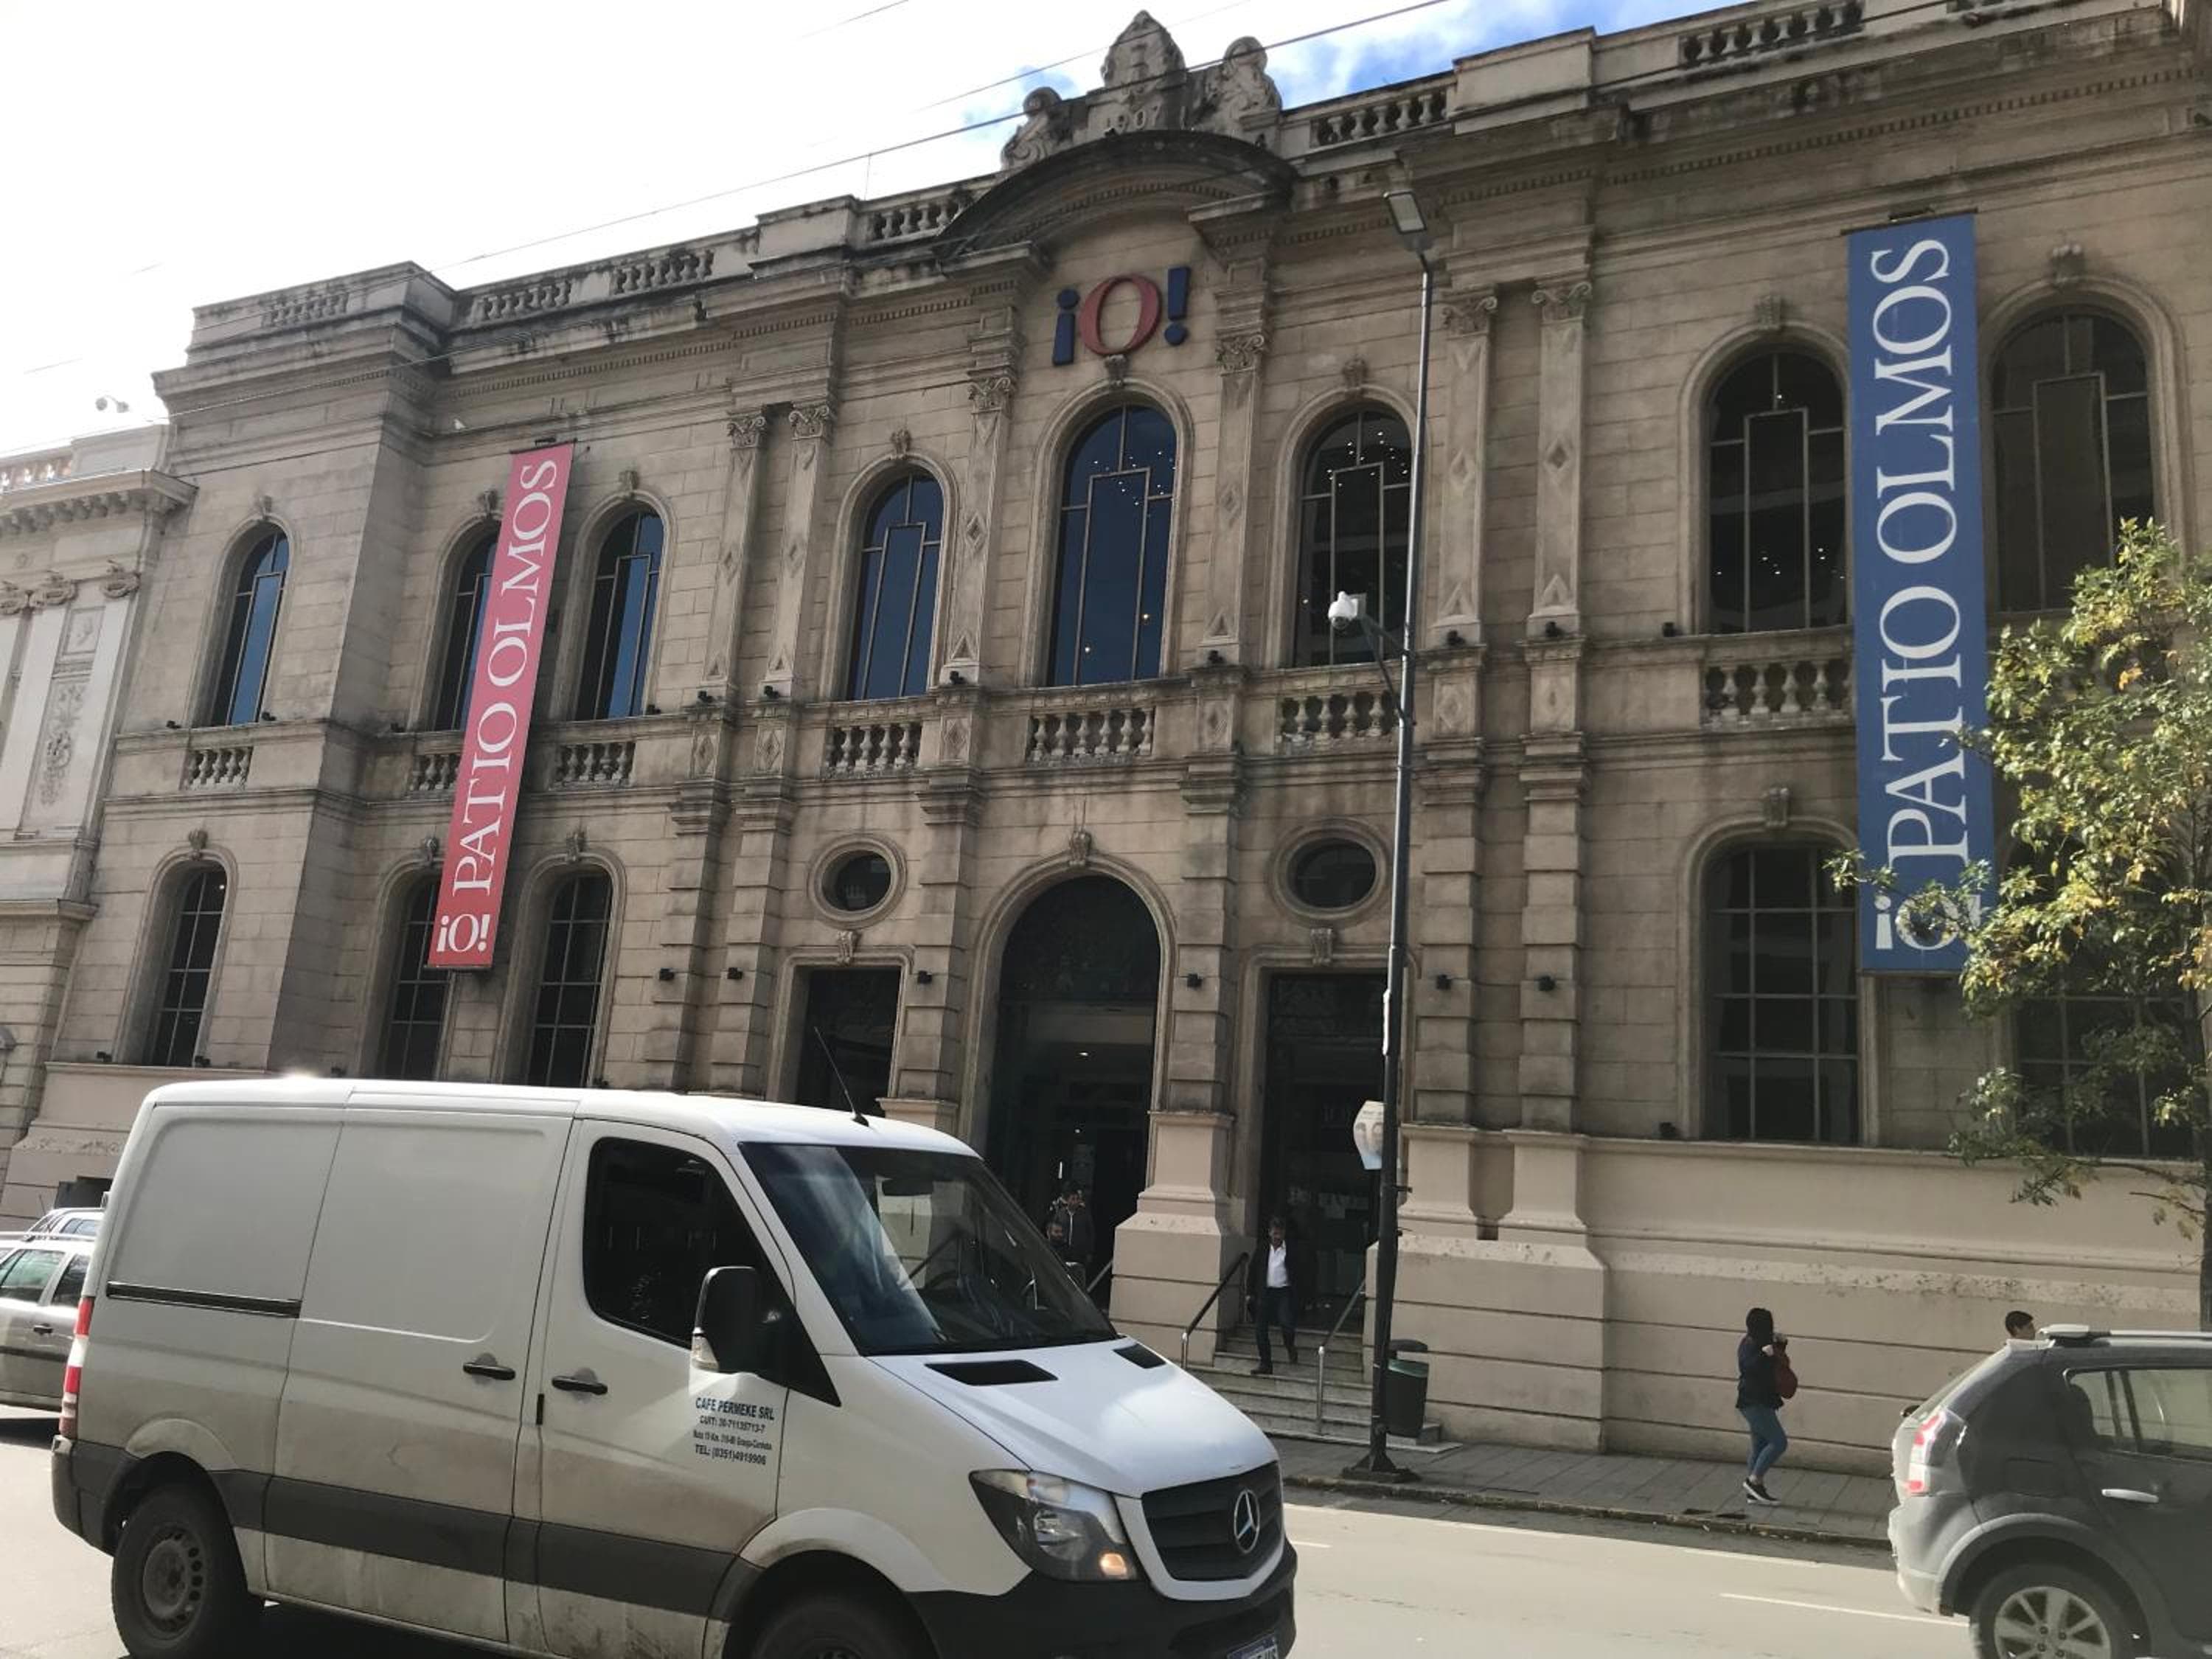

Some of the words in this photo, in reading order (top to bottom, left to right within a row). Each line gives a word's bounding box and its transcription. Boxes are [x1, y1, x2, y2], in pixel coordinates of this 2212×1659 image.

[1870, 240, 1958, 564] OLMOS
[452, 702, 518, 897] PATIO
[487, 460, 557, 686] OLMOS
[1879, 586, 1969, 869] PATIO
[695, 1397, 716, 1411] CAFE
[717, 1400, 757, 1417] PERMEKE
[758, 1406, 774, 1420] SRL
[695, 1444, 711, 1455] TEL:
